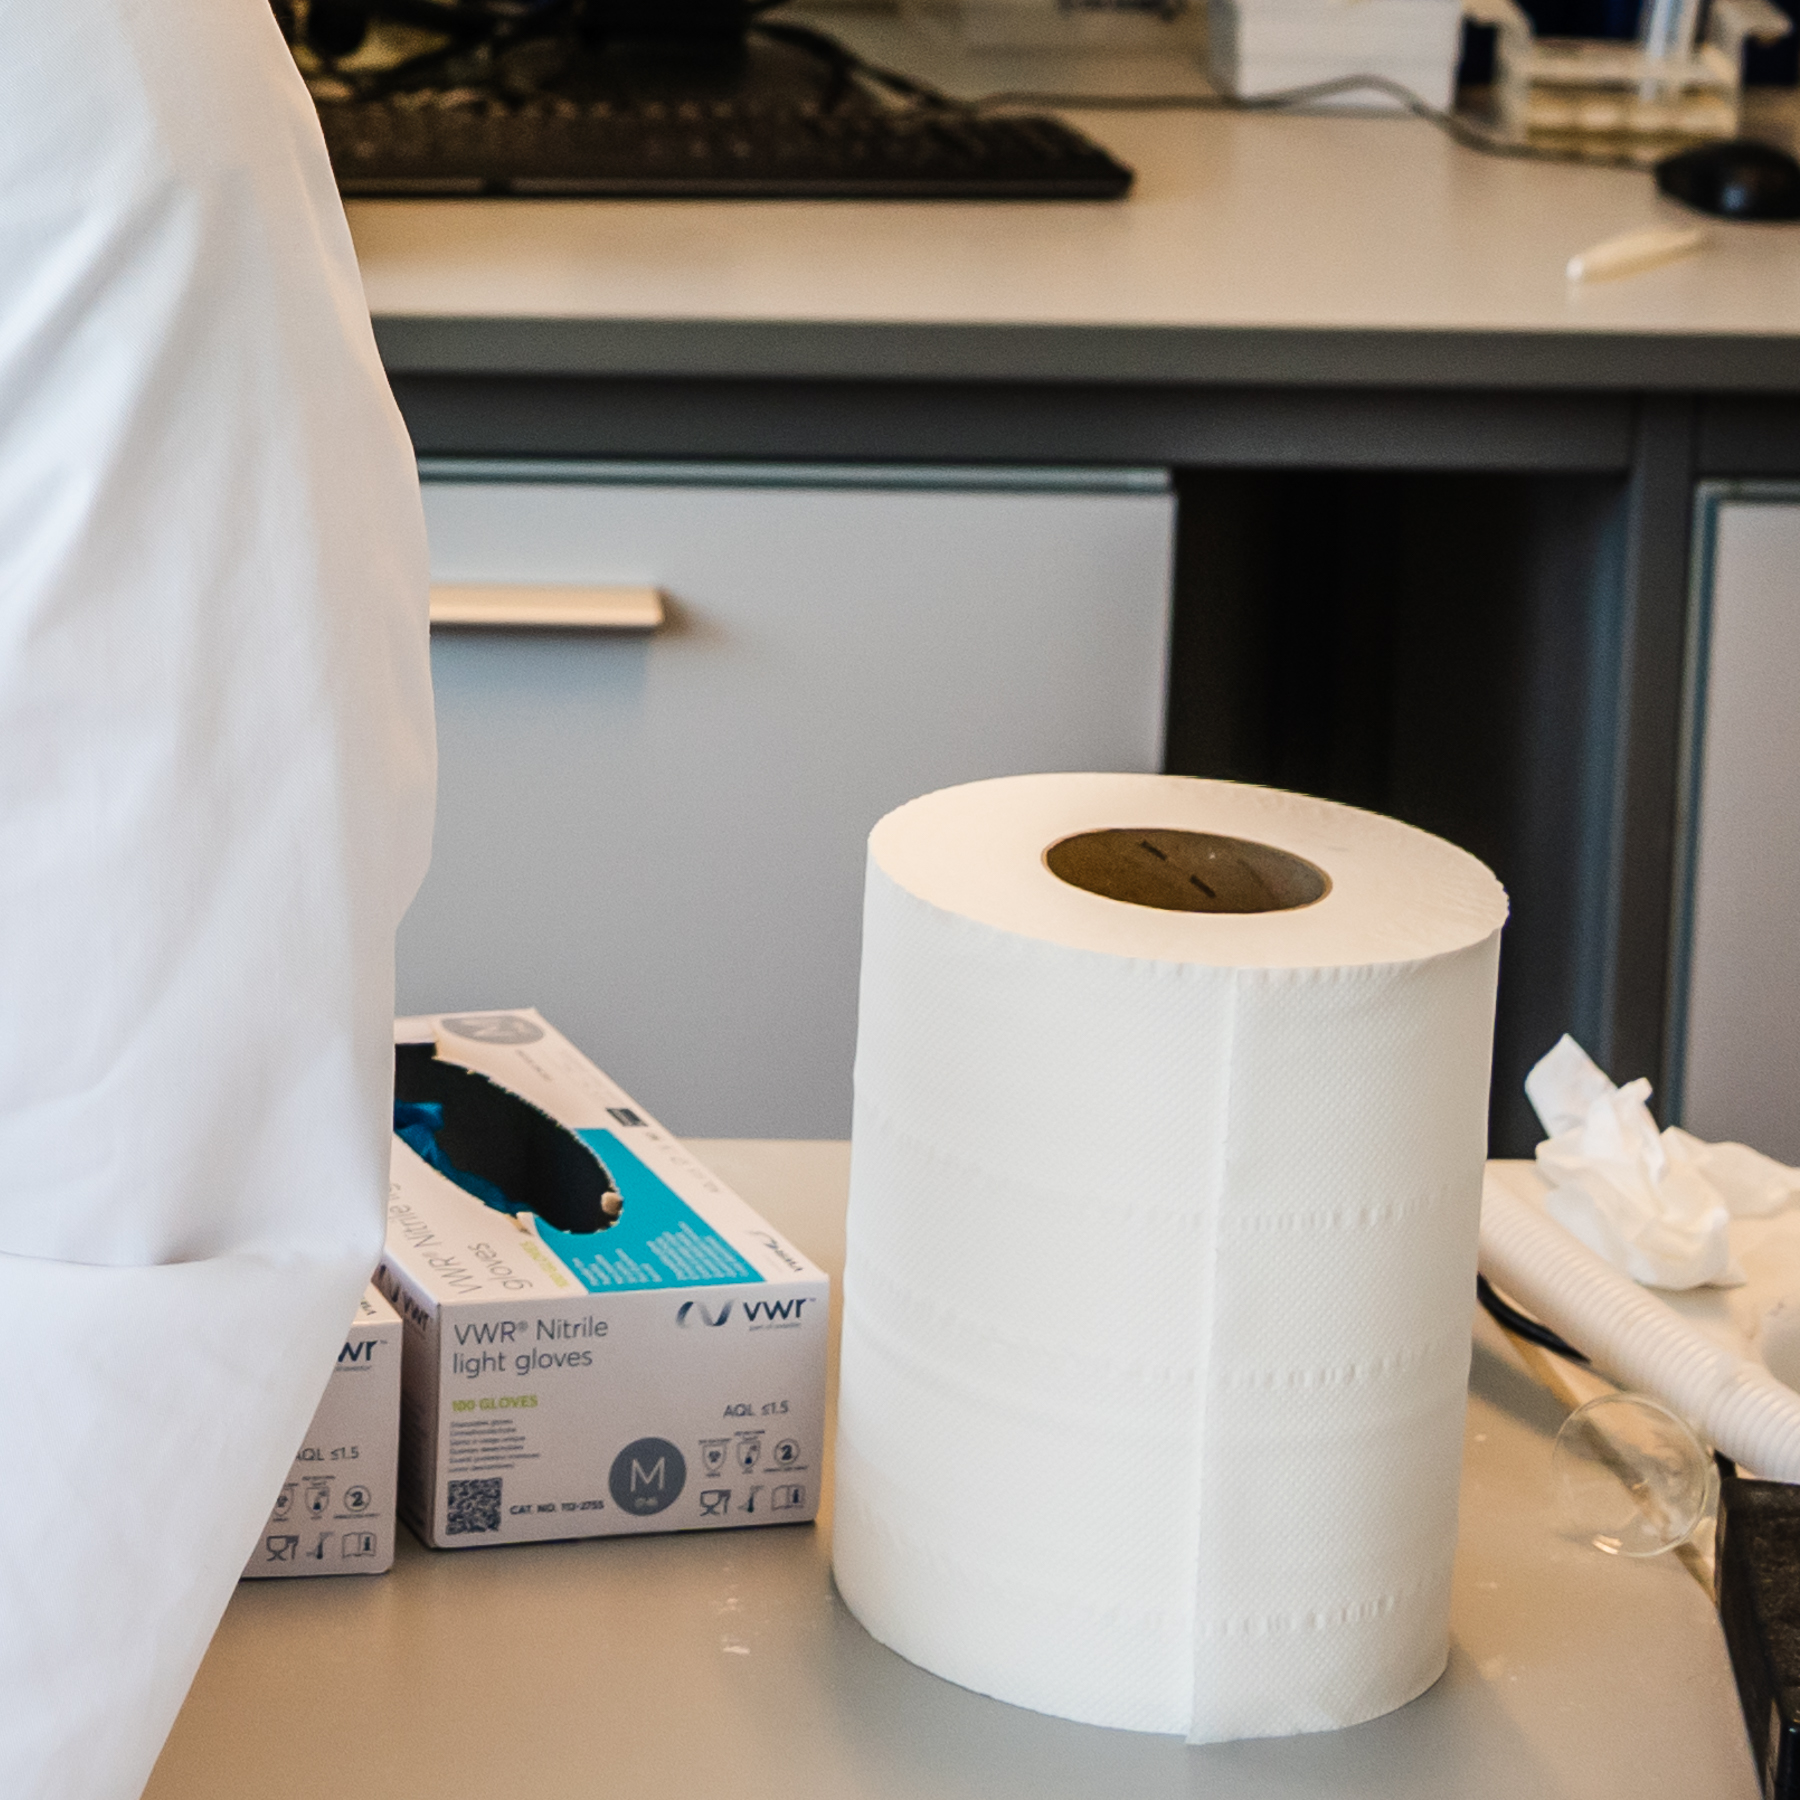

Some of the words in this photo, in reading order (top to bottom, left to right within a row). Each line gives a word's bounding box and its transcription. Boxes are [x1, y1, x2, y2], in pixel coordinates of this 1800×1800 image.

[536, 1316, 609, 1341] Nitrile
[337, 1340, 378, 1362] wr
[453, 1350, 506, 1379] light
[515, 1348, 593, 1376] gloves
[479, 1394, 538, 1411] GLOVES
[723, 1402, 756, 1418] AQL
[630, 1456, 666, 1492] M
